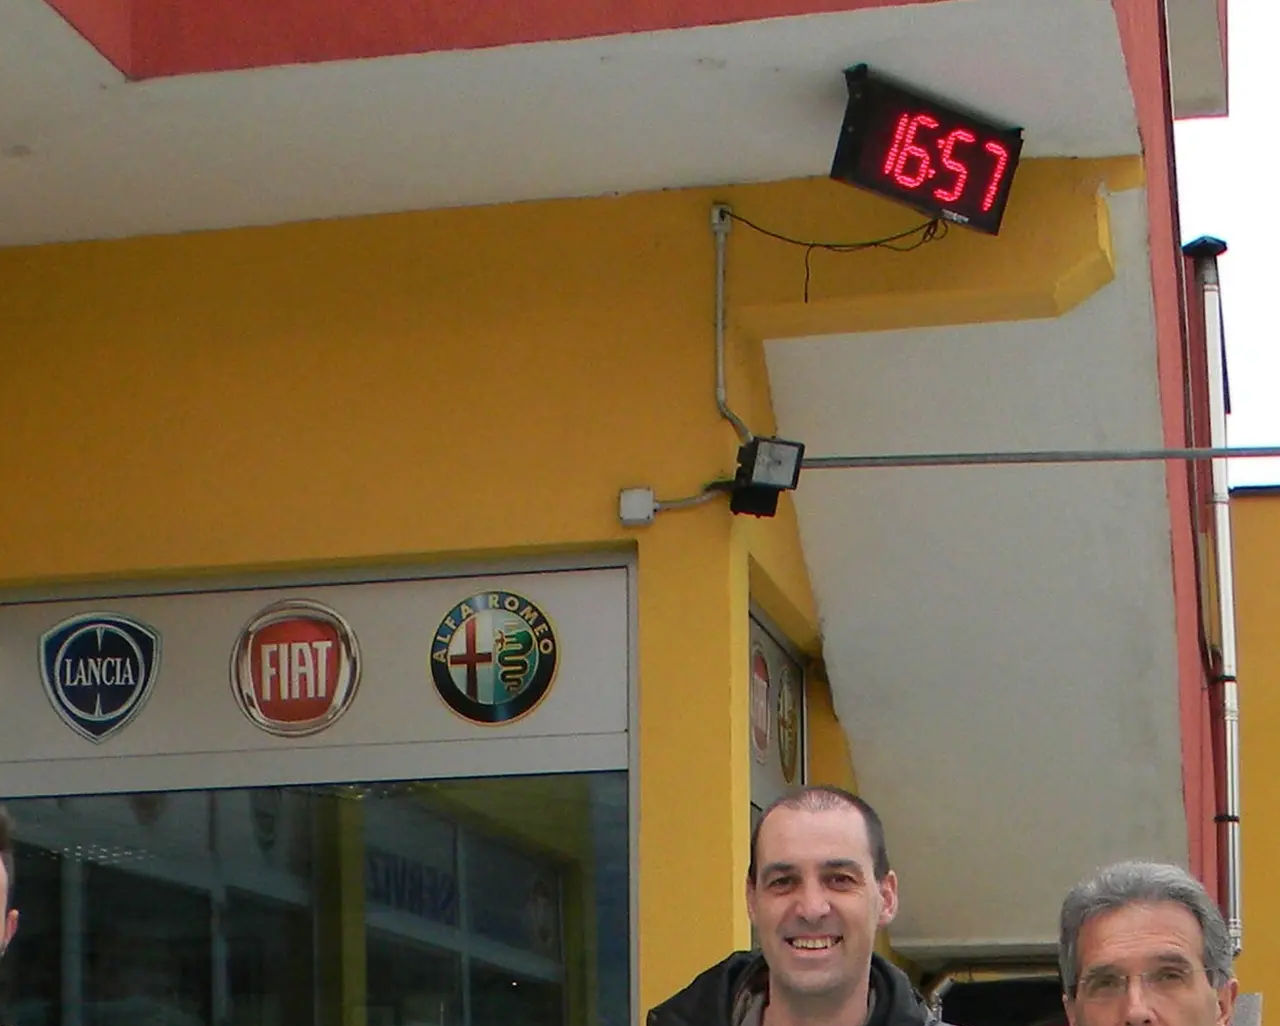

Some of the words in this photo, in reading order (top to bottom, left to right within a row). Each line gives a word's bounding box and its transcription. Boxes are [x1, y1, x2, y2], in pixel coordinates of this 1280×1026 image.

[884, 113, 1008, 212] 16:57
[432, 603, 474, 664] ALFA
[487, 593, 555, 655] ROMEO
[64, 657, 135, 687] LANCIA
[260, 640, 333, 701] FIAT
